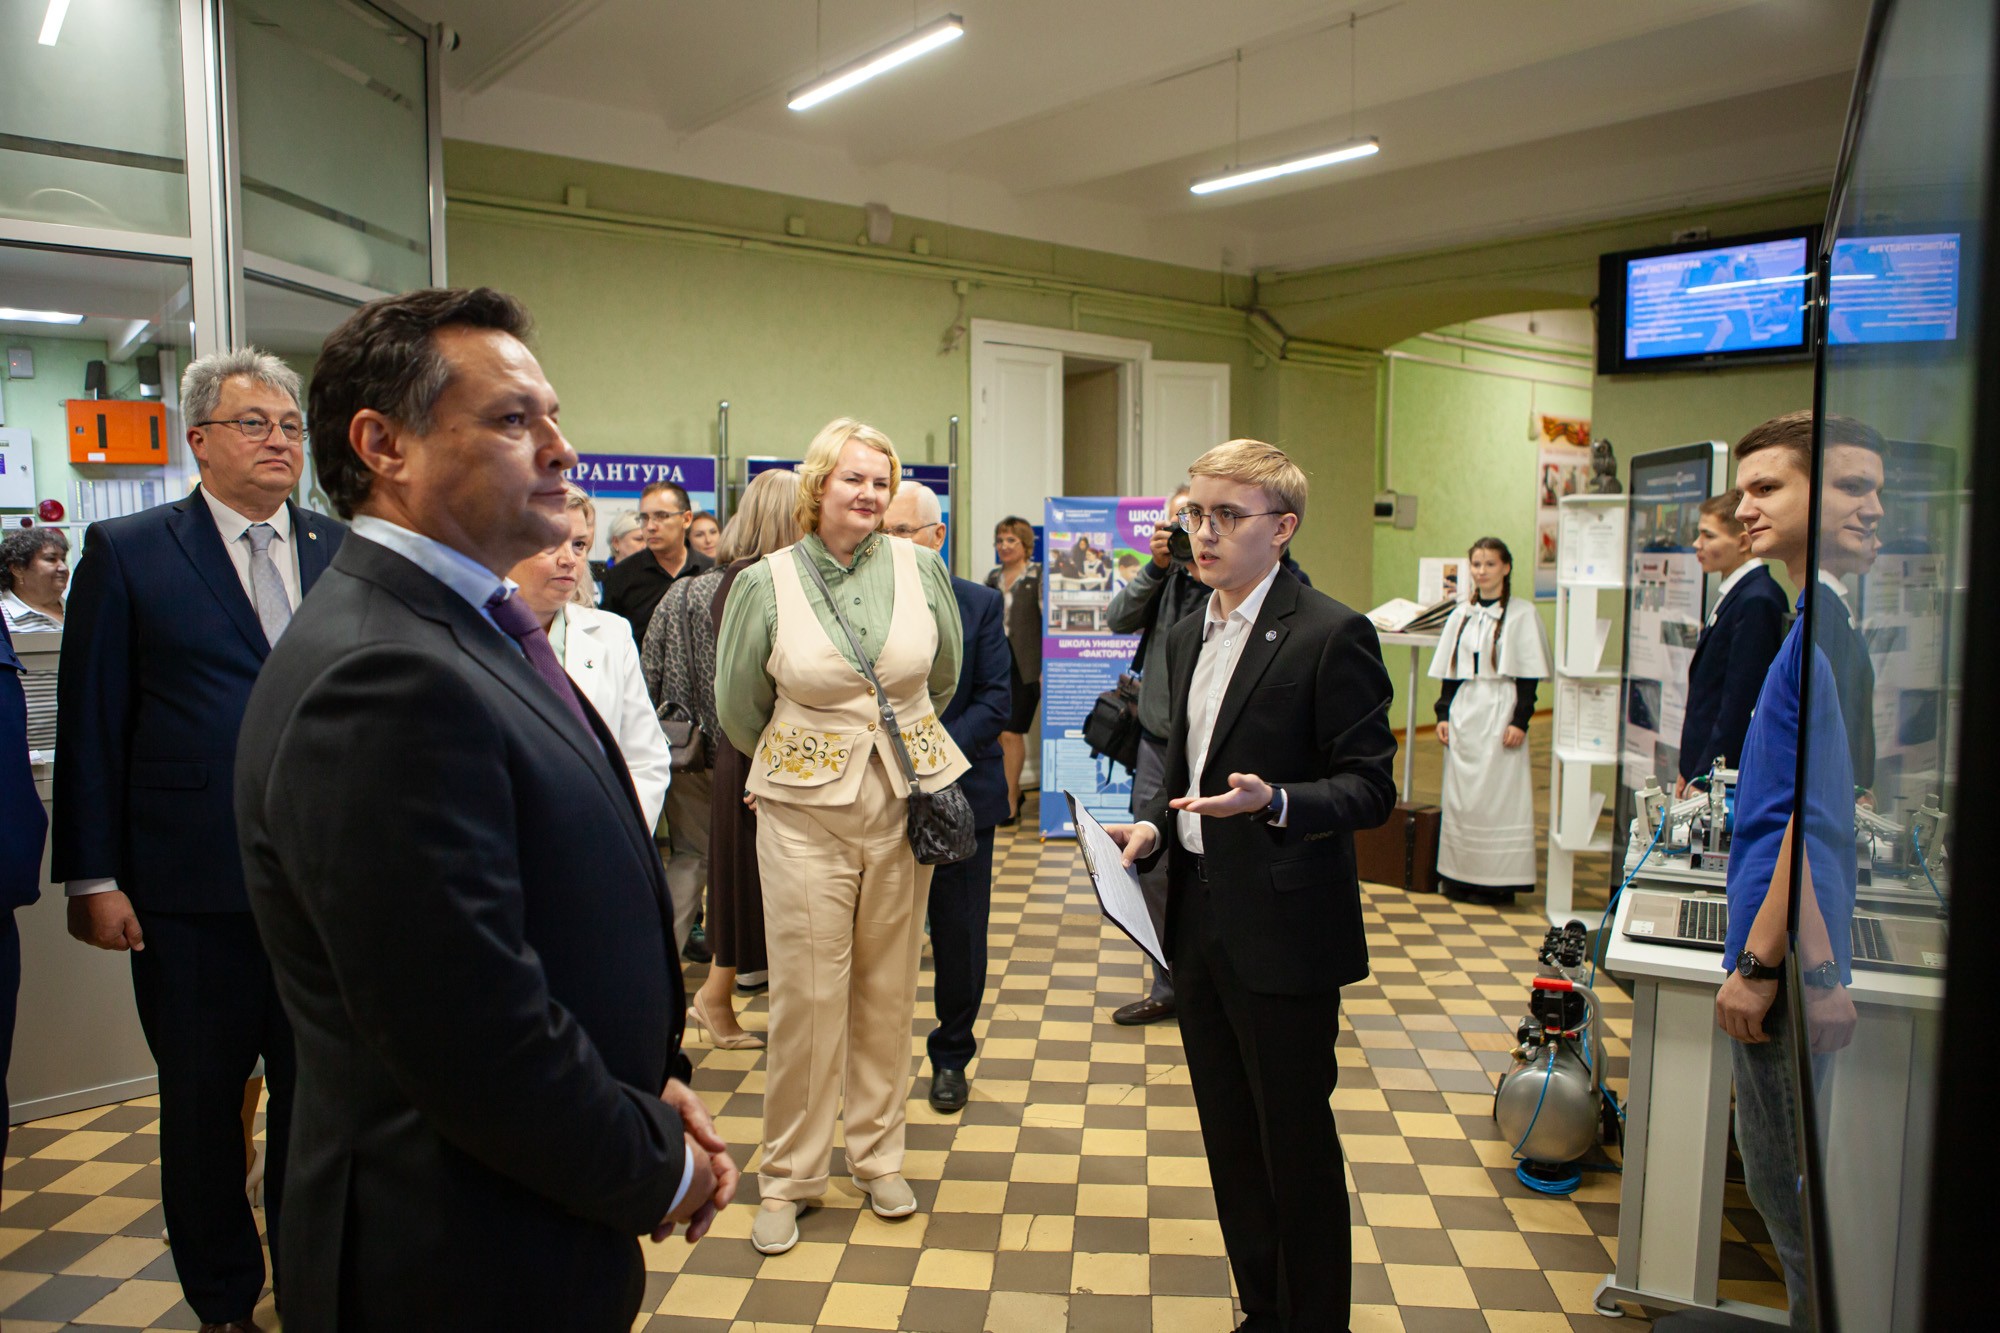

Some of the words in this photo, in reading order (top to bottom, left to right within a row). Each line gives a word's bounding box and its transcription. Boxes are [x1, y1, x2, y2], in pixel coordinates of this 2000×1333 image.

[1059, 639, 1091, 648] ШКОЛА
[1092, 640, 1140, 648] УНИВЕРСИ
[1079, 650, 1126, 658] «ФАКТОРЫ
